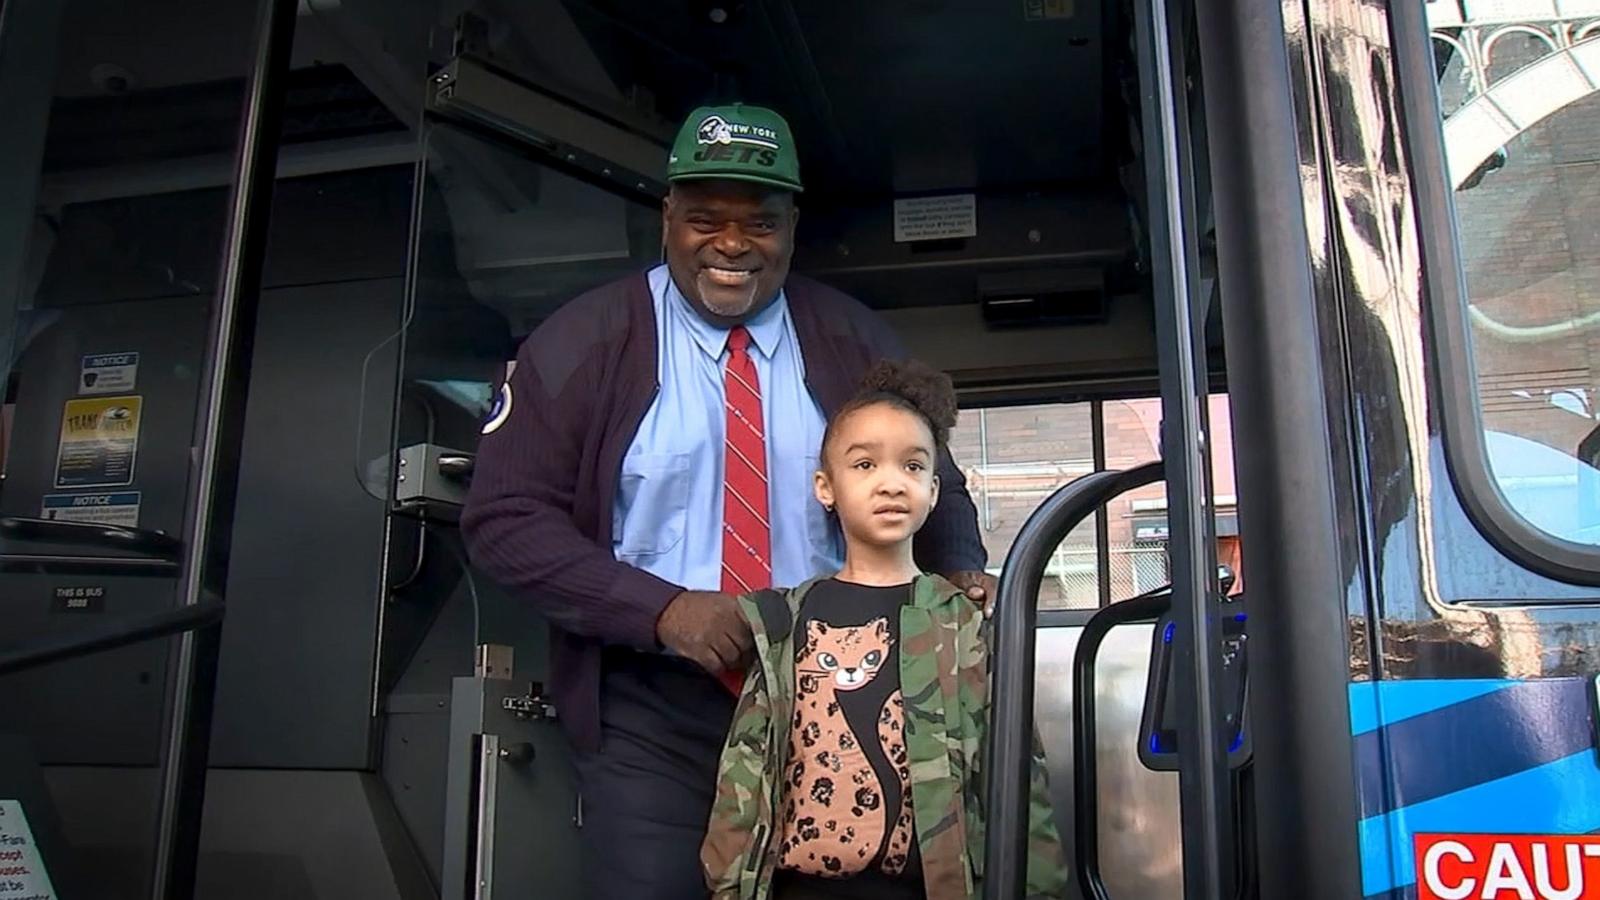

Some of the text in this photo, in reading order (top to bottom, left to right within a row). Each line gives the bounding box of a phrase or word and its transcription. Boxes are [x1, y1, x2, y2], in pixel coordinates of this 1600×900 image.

[725, 123, 777, 139] NEW YORK
[693, 144, 779, 167] JETS
[92, 356, 129, 366] NOTICE
[72, 495, 113, 506] NOTICE
[56, 587, 104, 598] THIS IS BUS
